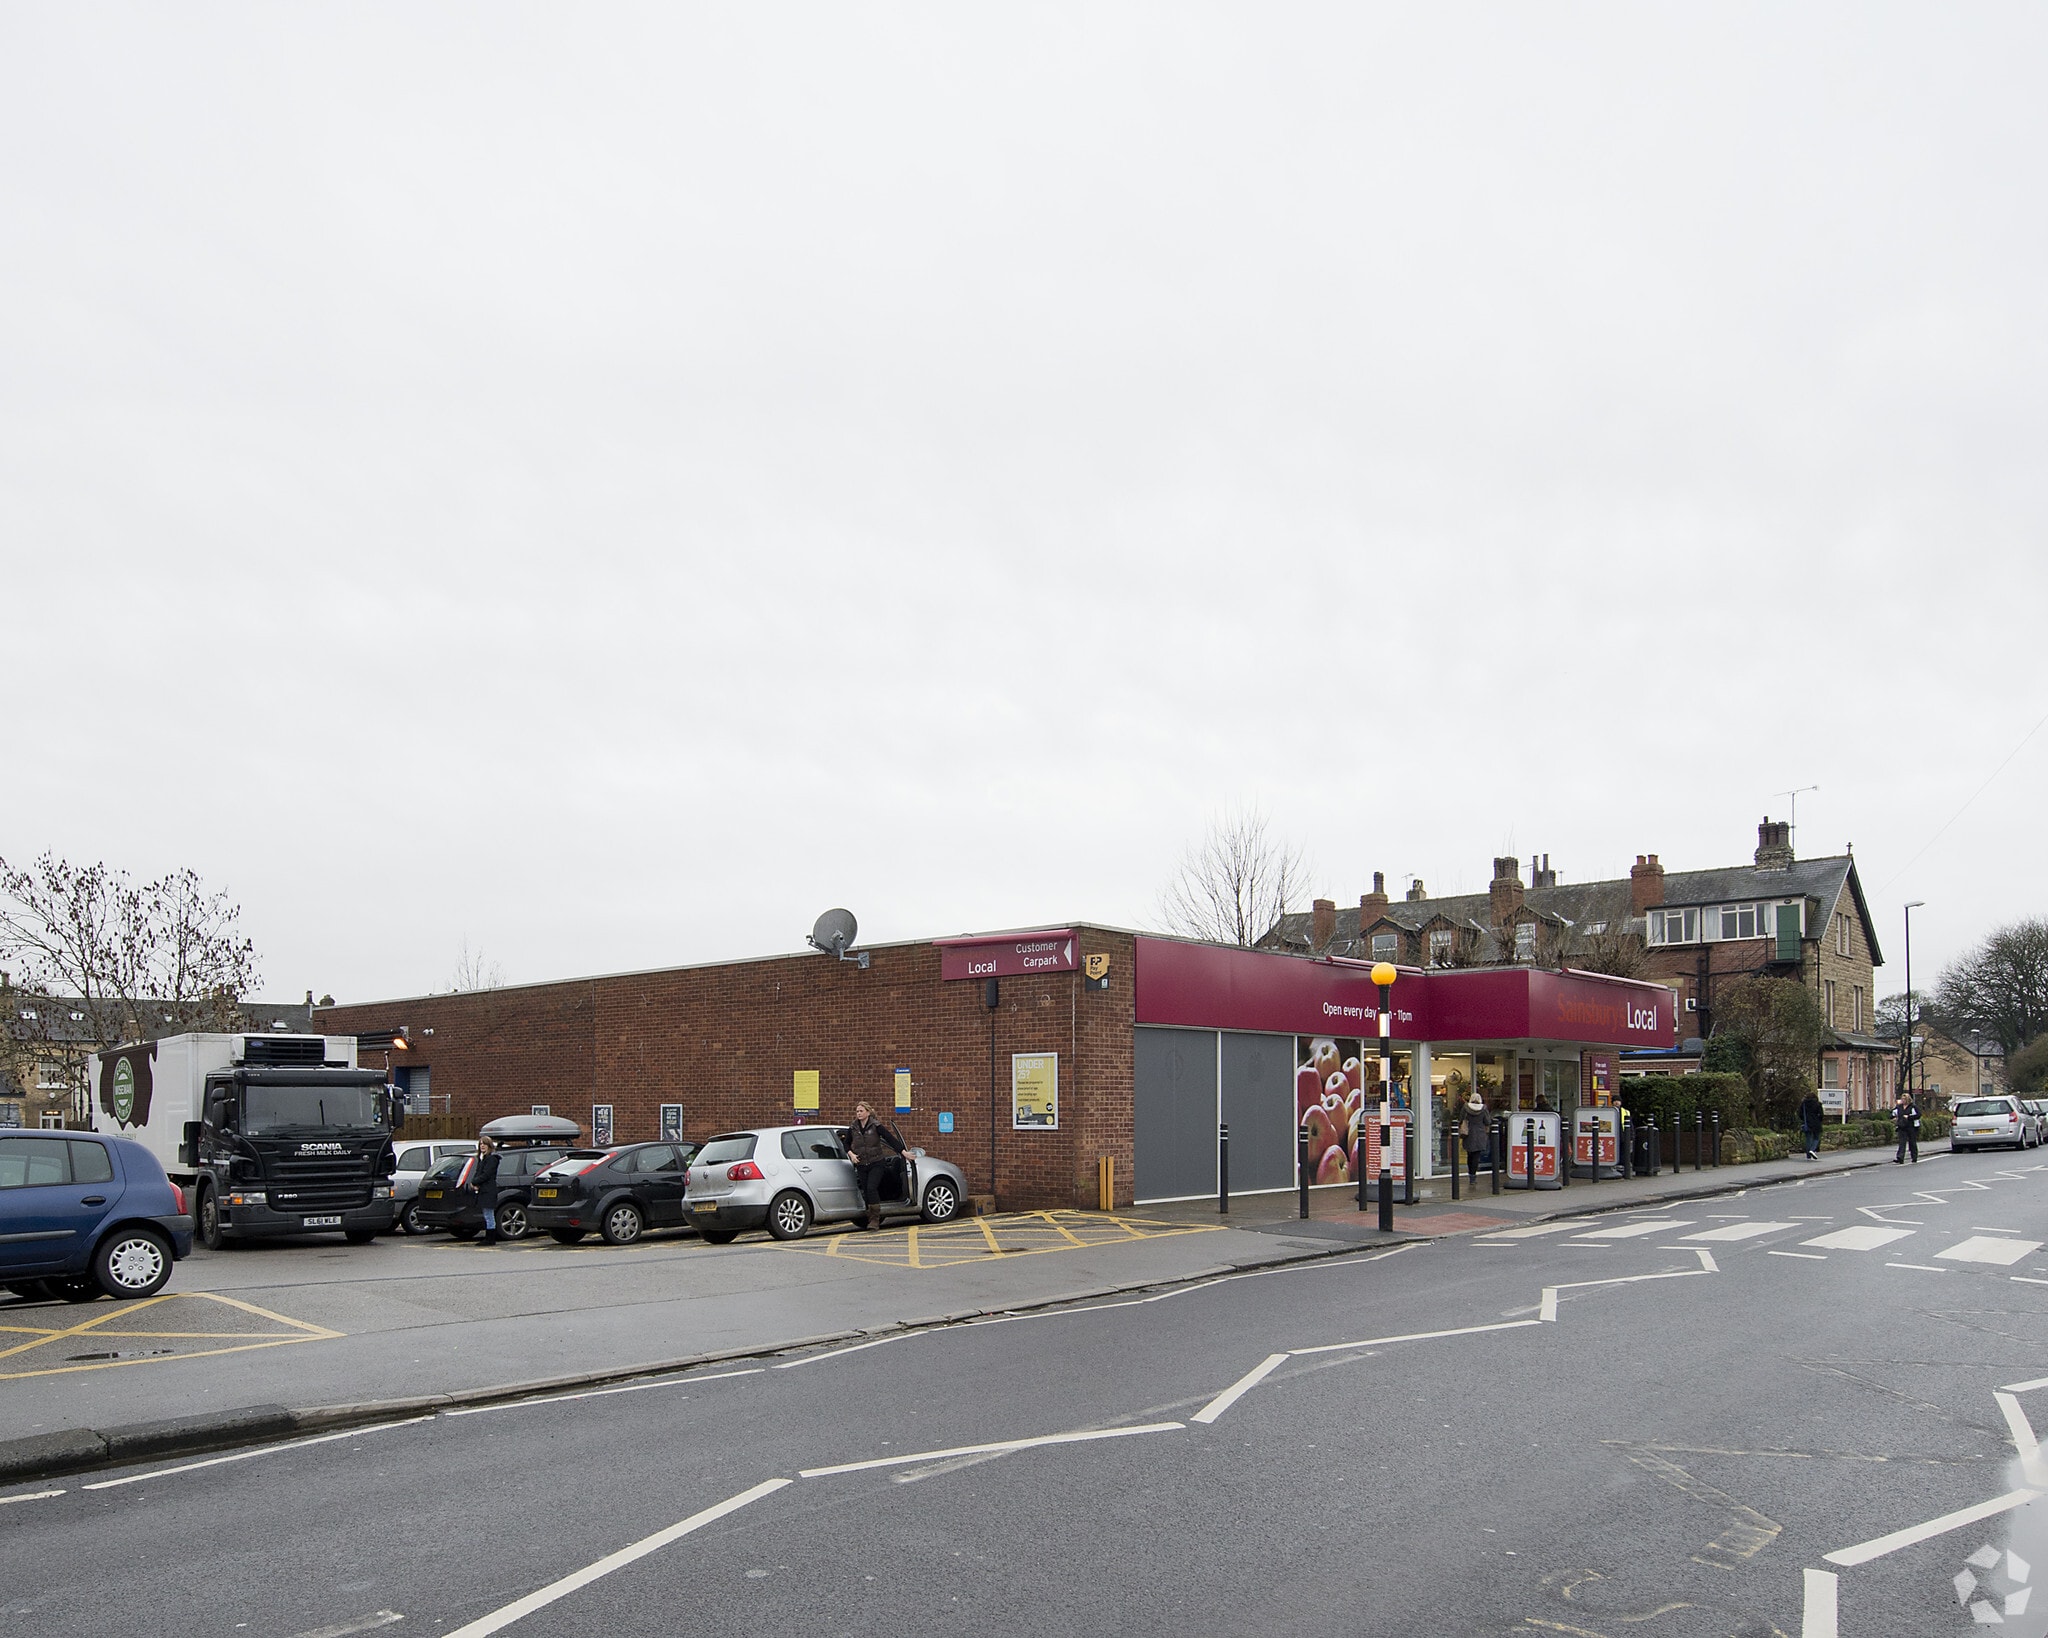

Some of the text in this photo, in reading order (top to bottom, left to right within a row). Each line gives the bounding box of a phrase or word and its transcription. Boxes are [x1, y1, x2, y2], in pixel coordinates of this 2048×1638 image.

[1015, 941, 1058, 954] Customer
[968, 960, 996, 974] Local
[1023, 955, 1058, 968] Carpark
[1323, 1002, 1342, 1017] Open
[1343, 1006, 1363, 1020] every
[1364, 1006, 1377, 1021] day
[1397, 1009, 1413, 1023] 11pm
[1558, 992, 1657, 1033] Sainsbury's Local
[1017, 1059, 1044, 1069] UNDER
[1017, 1069, 1031, 1079] 25?
[301, 1142, 343, 1151] SCANIA
